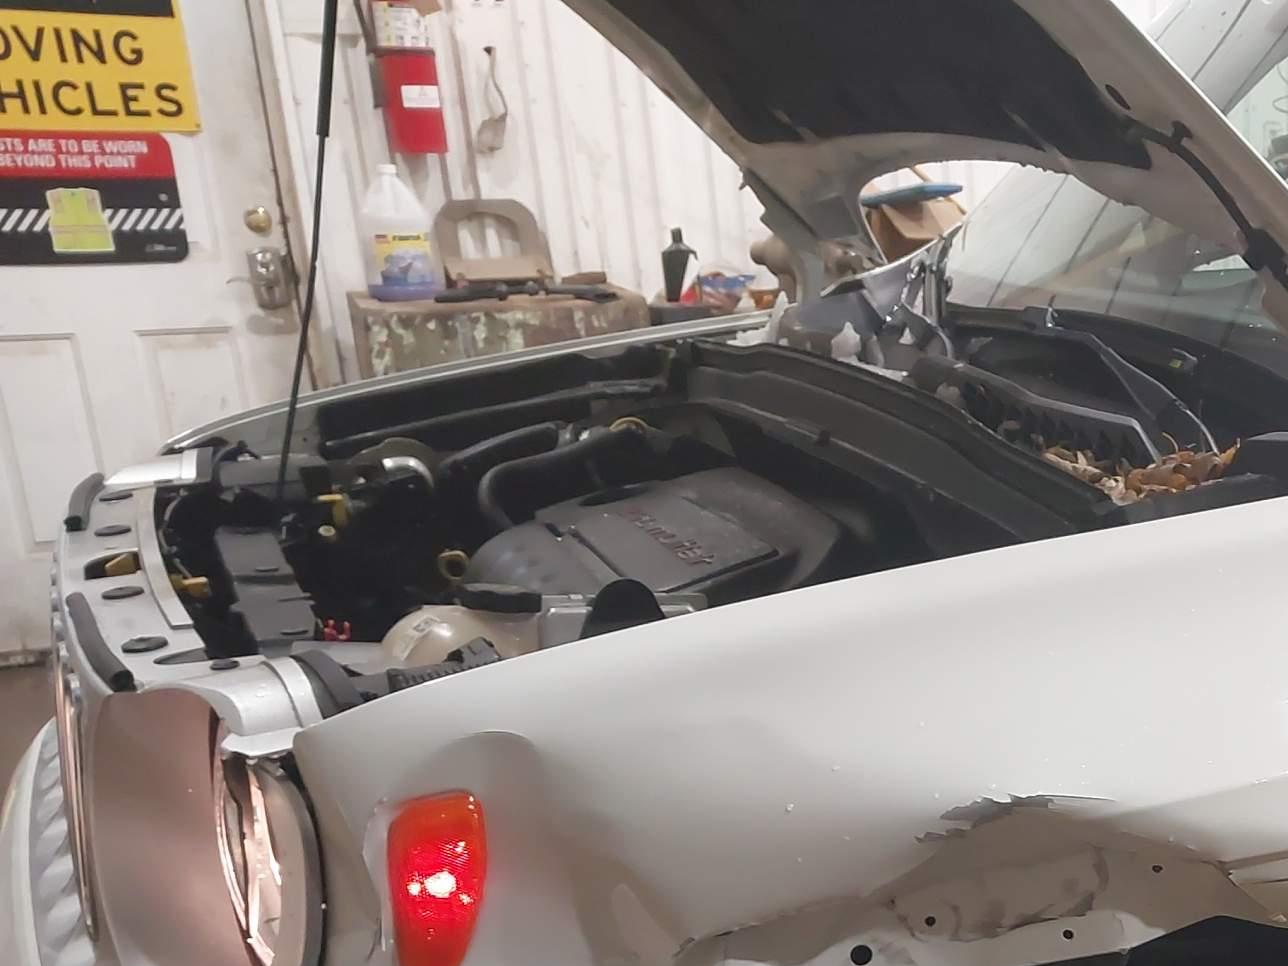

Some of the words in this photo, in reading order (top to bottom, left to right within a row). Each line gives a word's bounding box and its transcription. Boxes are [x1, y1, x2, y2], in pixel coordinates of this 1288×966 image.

[28, 138, 56, 152] ARE
[58, 139, 78, 153] TO
[82, 140, 101, 153] BE
[101, 140, 148, 154] WORN
[58, 154, 92, 168] THIS
[95, 155, 137, 168] POINT
